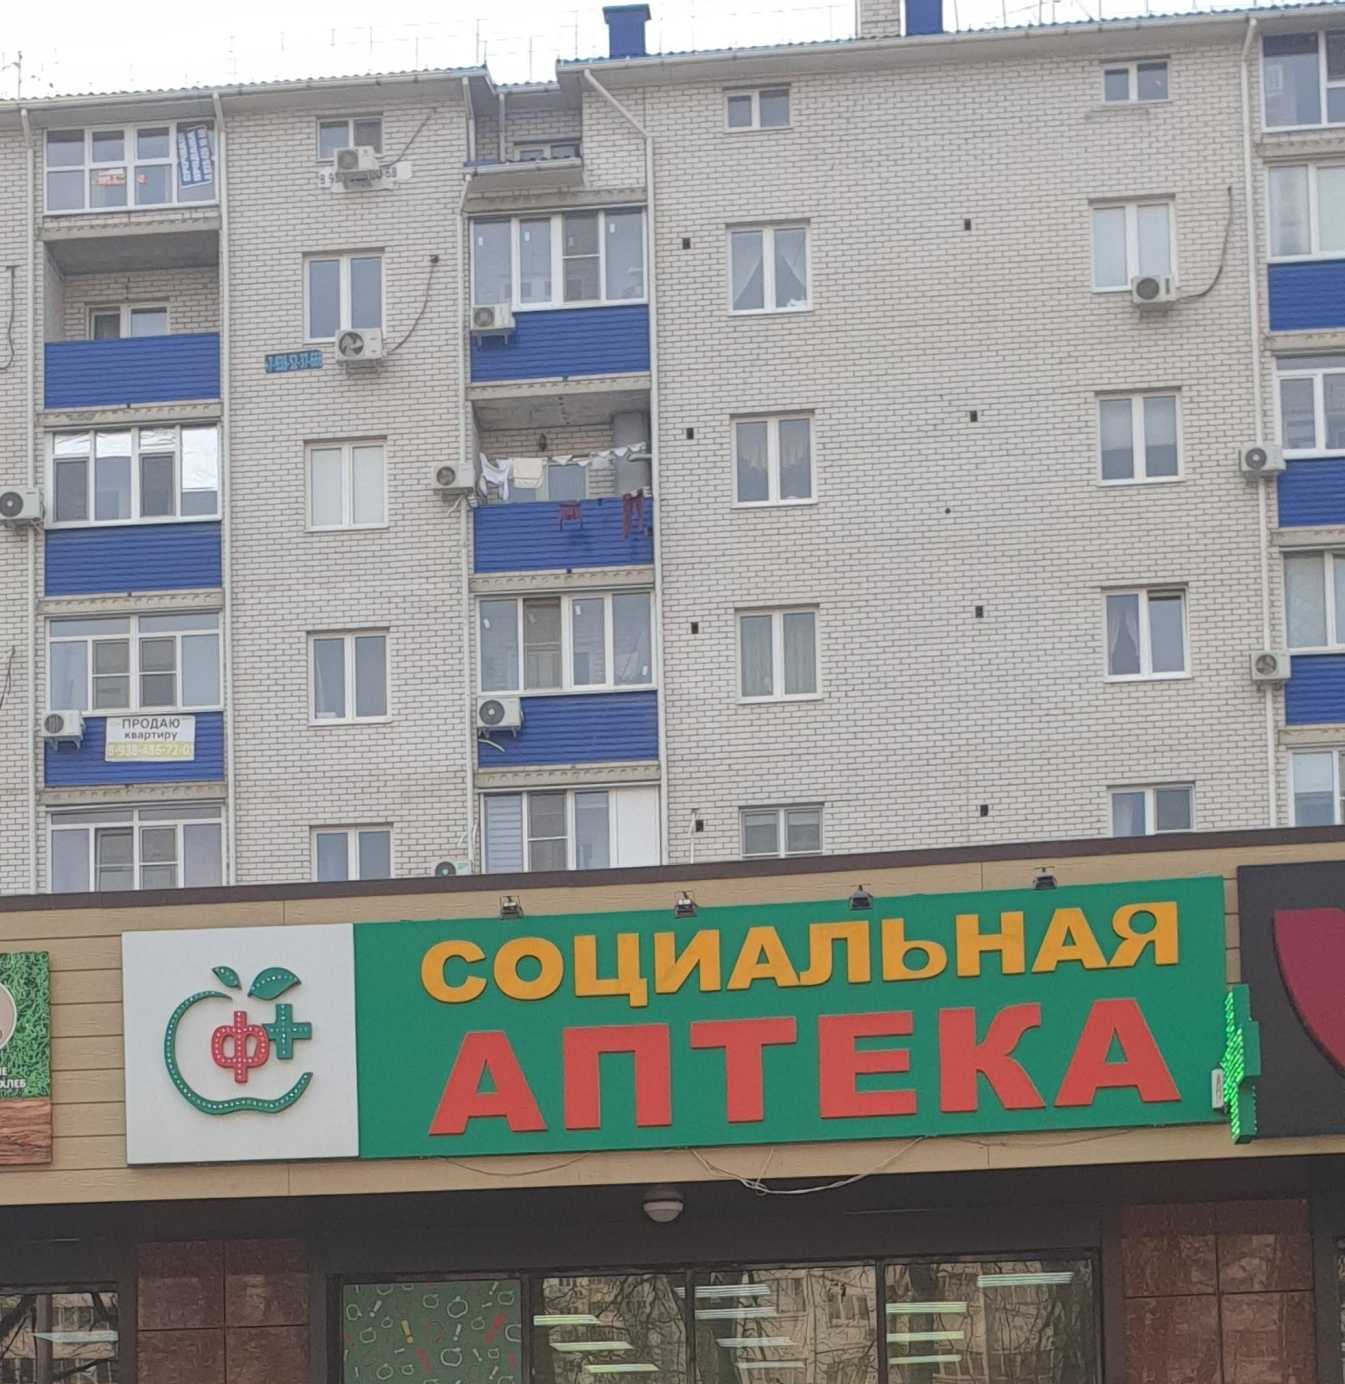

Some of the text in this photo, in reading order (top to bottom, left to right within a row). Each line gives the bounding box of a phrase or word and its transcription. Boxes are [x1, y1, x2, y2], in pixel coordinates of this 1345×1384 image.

[122, 719, 181, 729] ПРОДАЮ
[124, 732, 178, 741] квартиру
[420, 901, 1179, 1008] СОЦИАЛЬНАЯ
[428, 997, 1183, 1136] АПТЕКА
